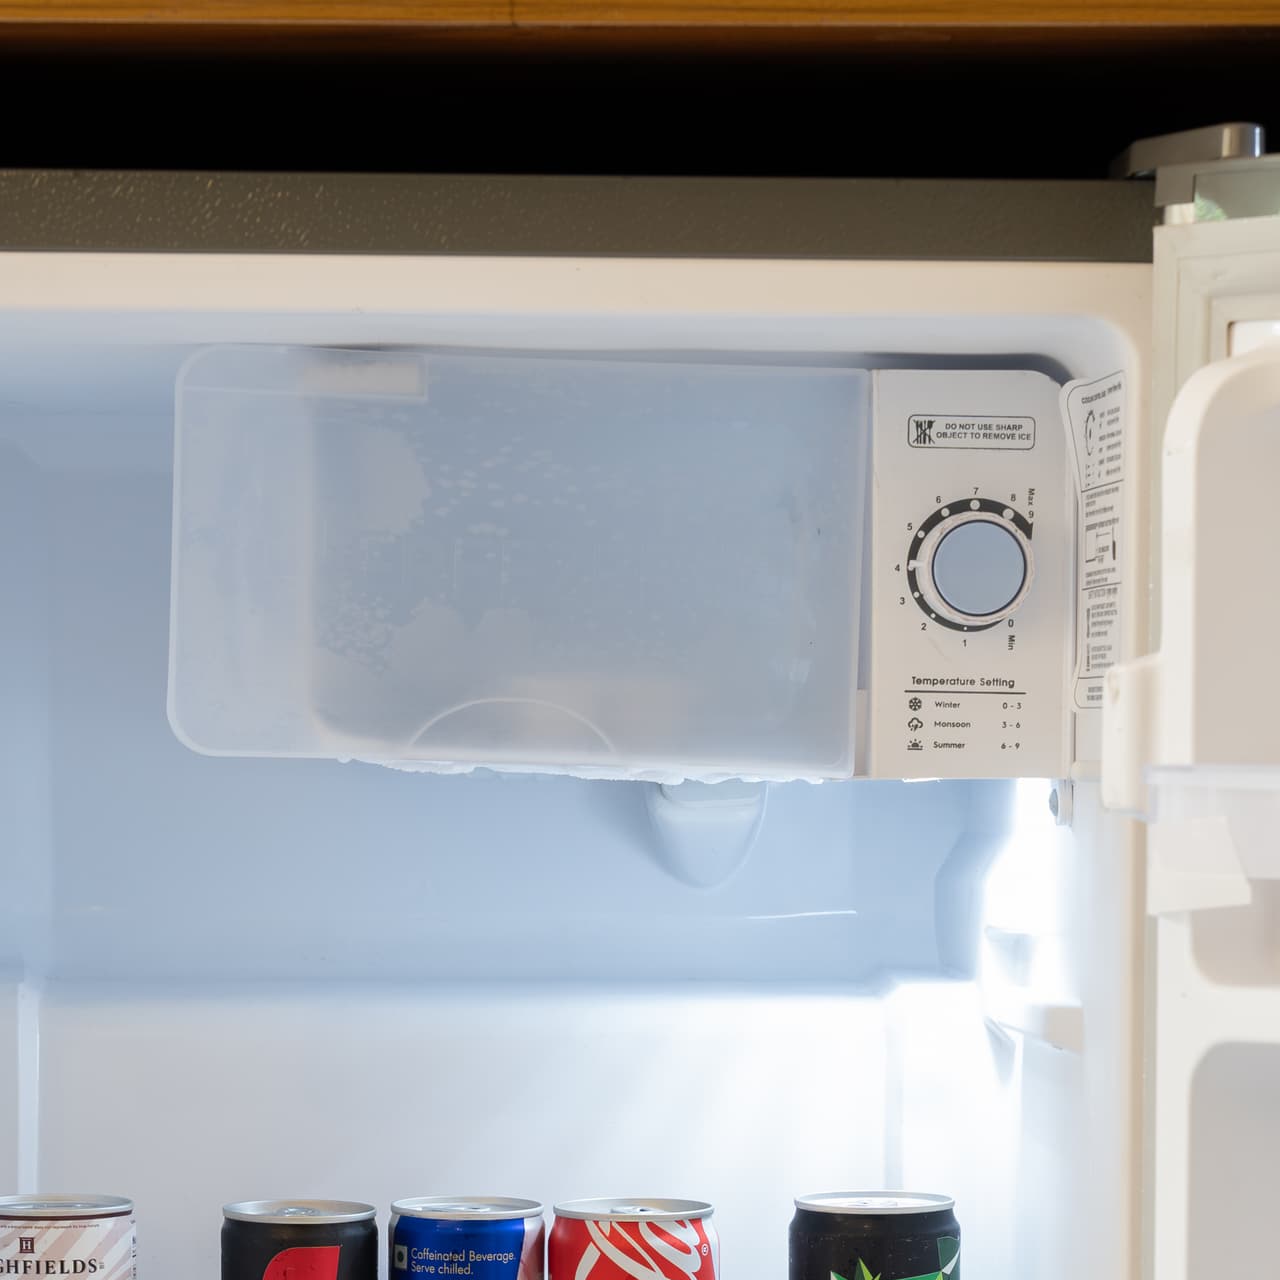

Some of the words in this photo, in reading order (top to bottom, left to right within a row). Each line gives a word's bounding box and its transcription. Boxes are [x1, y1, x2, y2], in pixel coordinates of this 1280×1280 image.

[936, 431, 967, 439] OBJECT
[982, 432, 1016, 440] REMOVE
[1018, 433, 1031, 441] ICE
[973, 487, 979, 495] 7
[1028, 510, 1034, 519] 9
[907, 523, 912, 531] 5
[894, 564, 900, 572] 4
[899, 597, 905, 605] 3
[921, 623, 927, 631] 2
[1008, 619, 1014, 627] 0
[963, 639, 967, 647] 1
[912, 676, 976, 687] Temperature
[980, 677, 1016, 689] Setting
[934, 701, 961, 709] Winter
[934, 721, 971, 729] Monsoon
[933, 741, 965, 749] Summer
[411, 1248, 465, 1262] Caffeinated
[469, 1250, 516, 1264] Beverage.
[411, 1261, 435, 1274] Serve
[438, 1263, 473, 1275] chilled.
